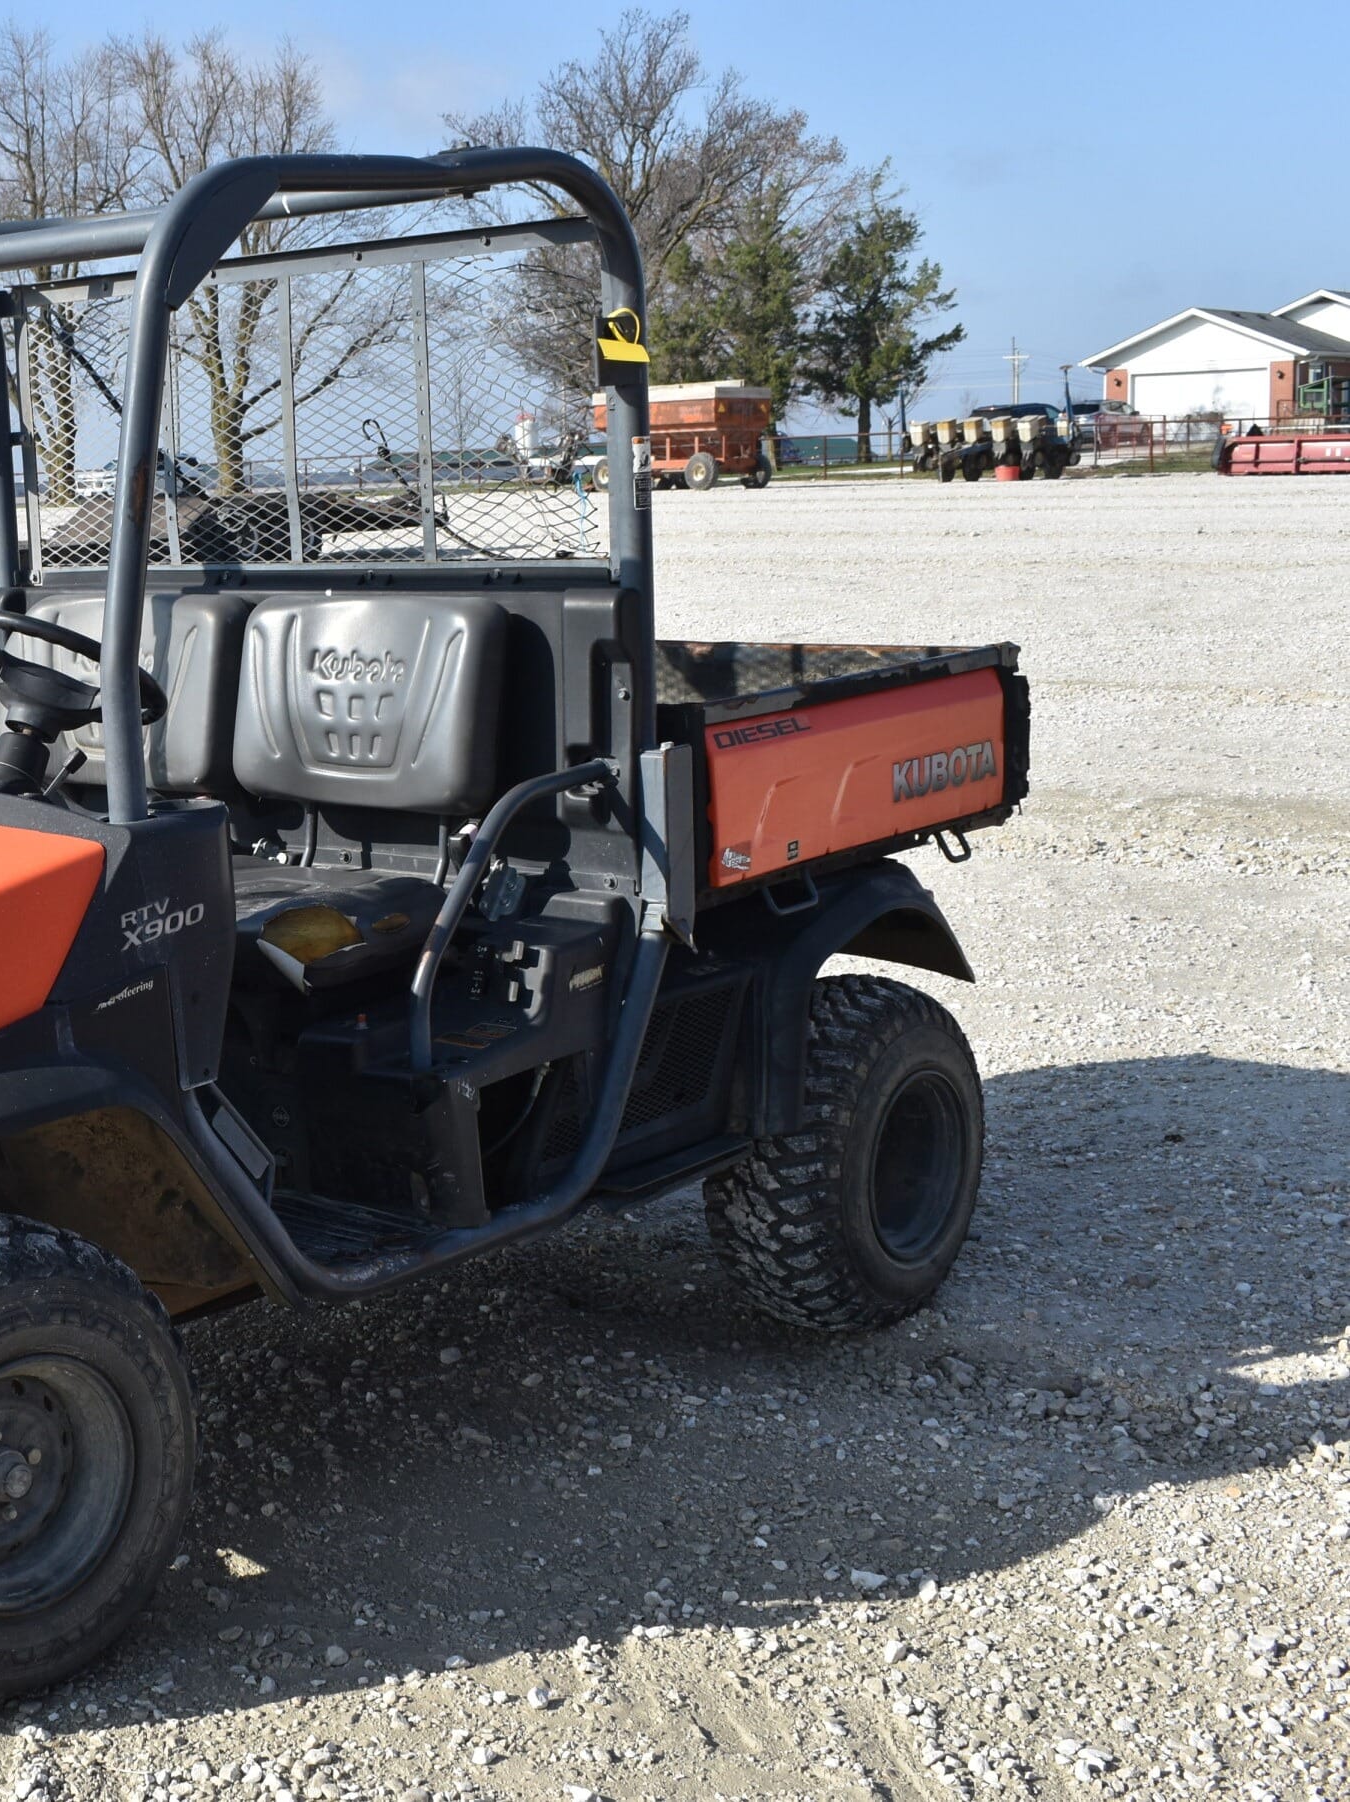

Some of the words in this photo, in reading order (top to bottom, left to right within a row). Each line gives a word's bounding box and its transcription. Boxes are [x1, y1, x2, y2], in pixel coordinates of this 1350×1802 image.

[713, 716, 812, 750] DIESEL
[892, 740, 998, 804] KUBOTA
[120, 897, 170, 929] RTV
[120, 902, 205, 953] X900
